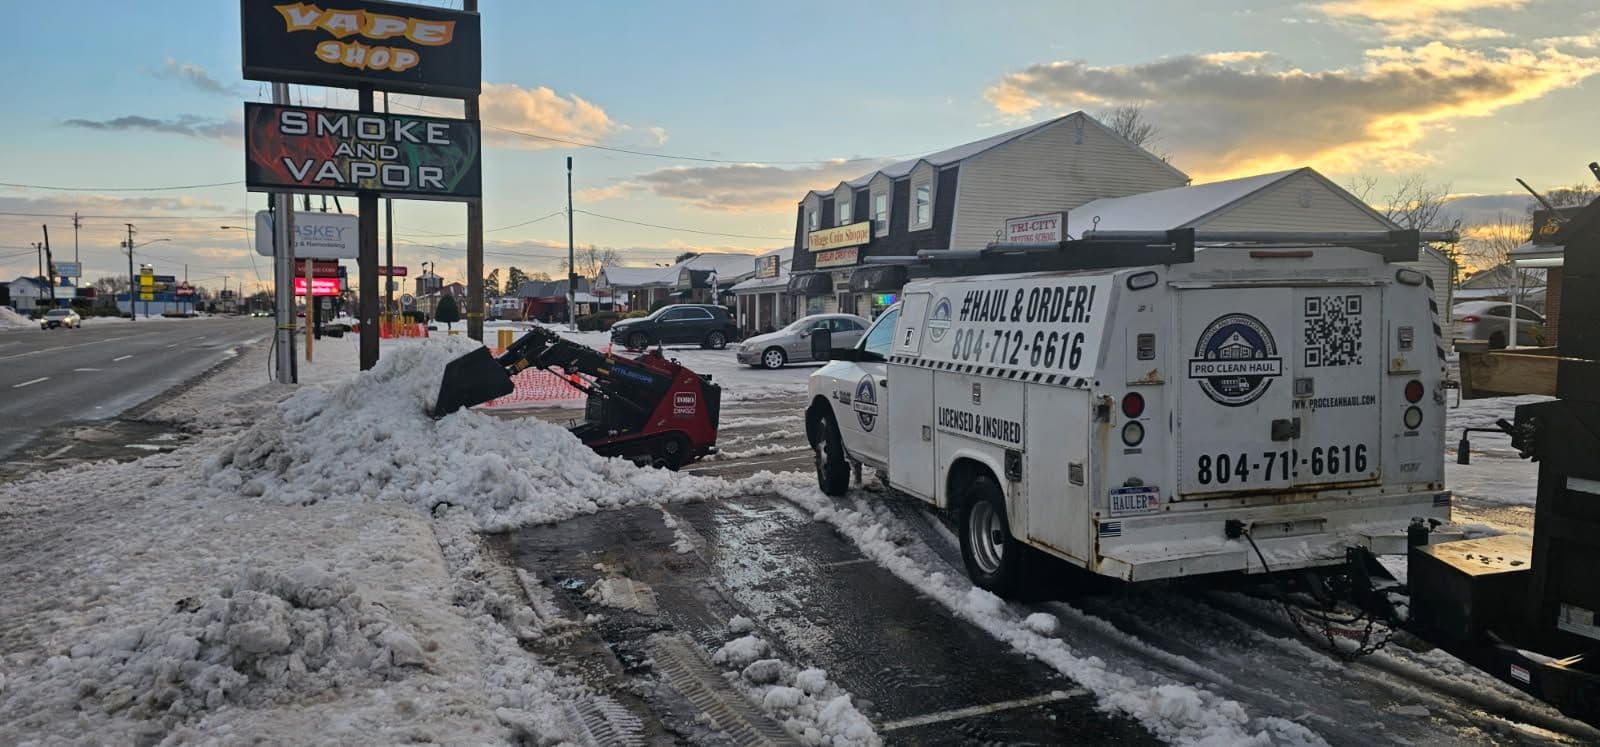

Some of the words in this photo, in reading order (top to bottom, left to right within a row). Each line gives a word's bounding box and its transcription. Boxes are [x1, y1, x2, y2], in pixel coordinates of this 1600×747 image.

[282, 7, 450, 43] VAPE
[319, 42, 416, 69] SHOP
[280, 111, 450, 145] SMOKE
[335, 142, 398, 160] AND
[283, 158, 445, 189] VAPOR
[809, 233, 829, 247] Village
[830, 231, 844, 243] Coin
[1010, 219, 1057, 233] TRI-CITY
[959, 289, 1009, 322] #HAUL
[1010, 288, 1024, 323] &
[1026, 285, 1096, 323] ORDER!
[952, 328, 1085, 371] 804-712-6616
[1195, 364, 1214, 373] PRO
[1216, 364, 1247, 373] CLEAN
[1249, 363, 1275, 372] HAUL
[938, 406, 973, 432] LICENSED
[975, 414, 981, 434] &
[982, 415, 1021, 444] INSURED
[1112, 494, 1148, 511] HAULER
